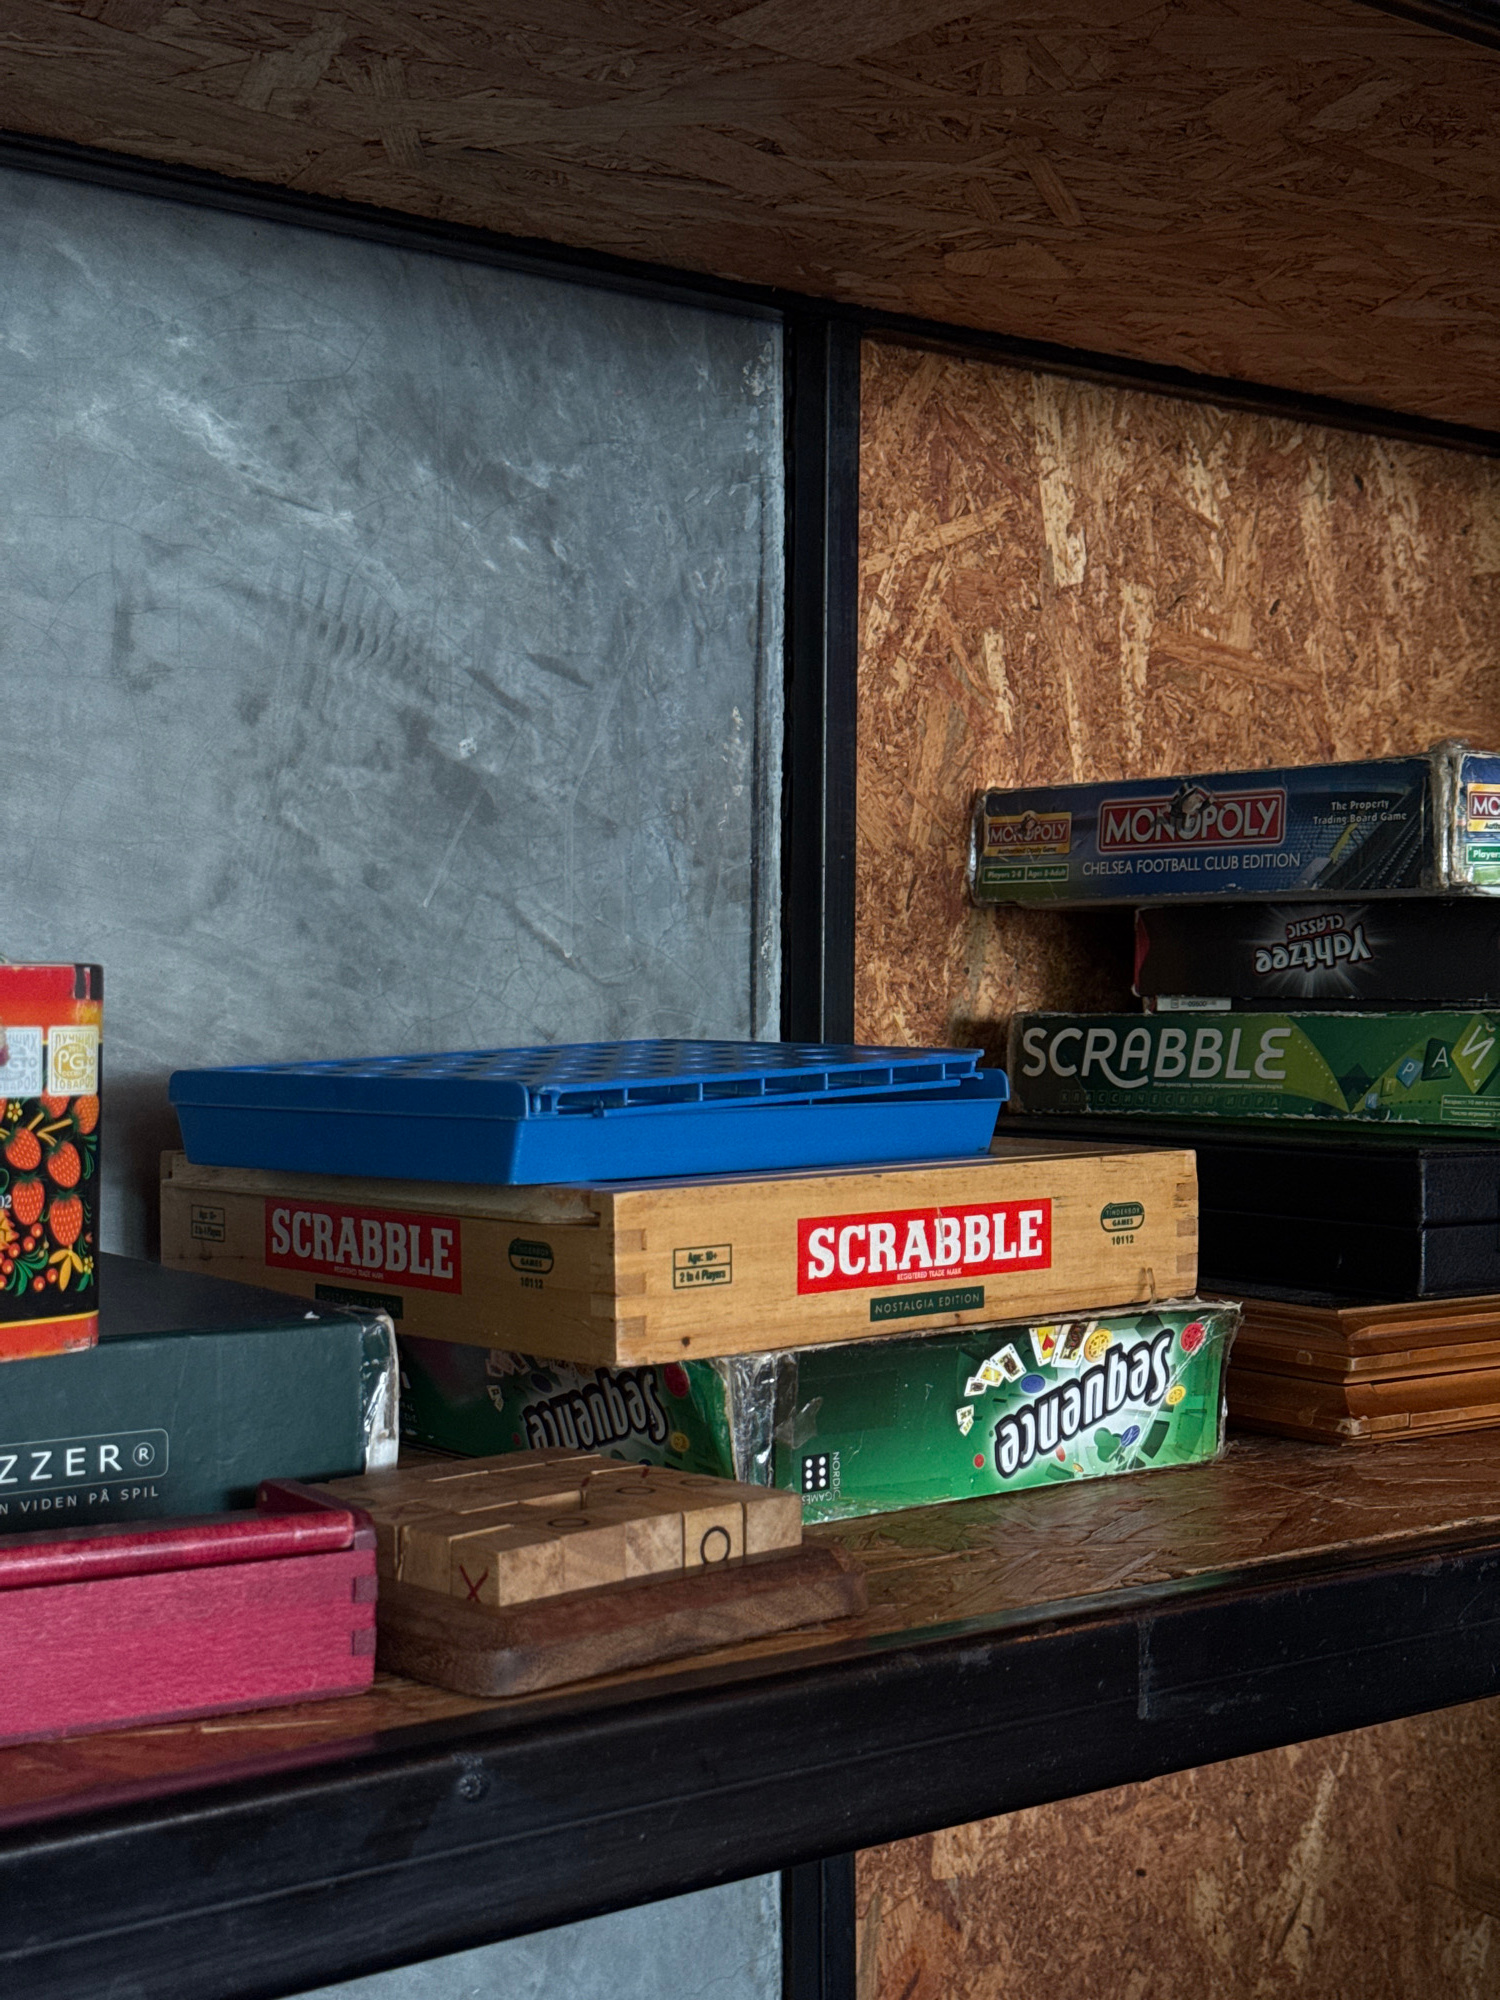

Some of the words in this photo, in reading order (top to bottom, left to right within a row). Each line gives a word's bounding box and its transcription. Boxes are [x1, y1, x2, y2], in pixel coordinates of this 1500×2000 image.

[1331, 801, 1347, 811] The
[1350, 800, 1390, 811] Property
[1313, 815, 1347, 826] Trading
[1350, 812, 1378, 823] Board
[1380, 812, 1408, 821] Game
[1082, 860, 1134, 876] CHELSEA
[1137, 857, 1201, 874] FOOTBALL
[1204, 855, 1239, 871] CLUB
[1243, 853, 1300, 870] EDITION
[1286, 914, 1345, 939] CLASSIC
[1254, 923, 1373, 974] Yahtzee
[1022, 1027, 1292, 1089] SCRABBLE
[1112, 1218, 1134, 1226] GAMES
[271, 1208, 454, 1279] SCRABBLE
[807, 1209, 1044, 1280] SCRABBLE
[1112, 1234, 1134, 1246] 10112
[679, 1271, 685, 1283] 2
[686, 1271, 694, 1282] to
[695, 1270, 700, 1281] 4
[701, 1269, 726, 1282] Players
[897, 1271, 928, 1281] REGISTERED
[929, 1269, 945, 1279] TRADE
[946, 1267, 962, 1276] MARK
[874, 1299, 935, 1315] NOSTALGIA
[938, 1292, 980, 1307] EDITION
[832, 1451, 841, 1501] NORDIC
[20, 1495, 77, 1513] VIDEN
[89, 1488, 110, 1504] PÅ
[121, 1485, 159, 1501] SPIL
[801, 1491, 833, 1504] GAMES
